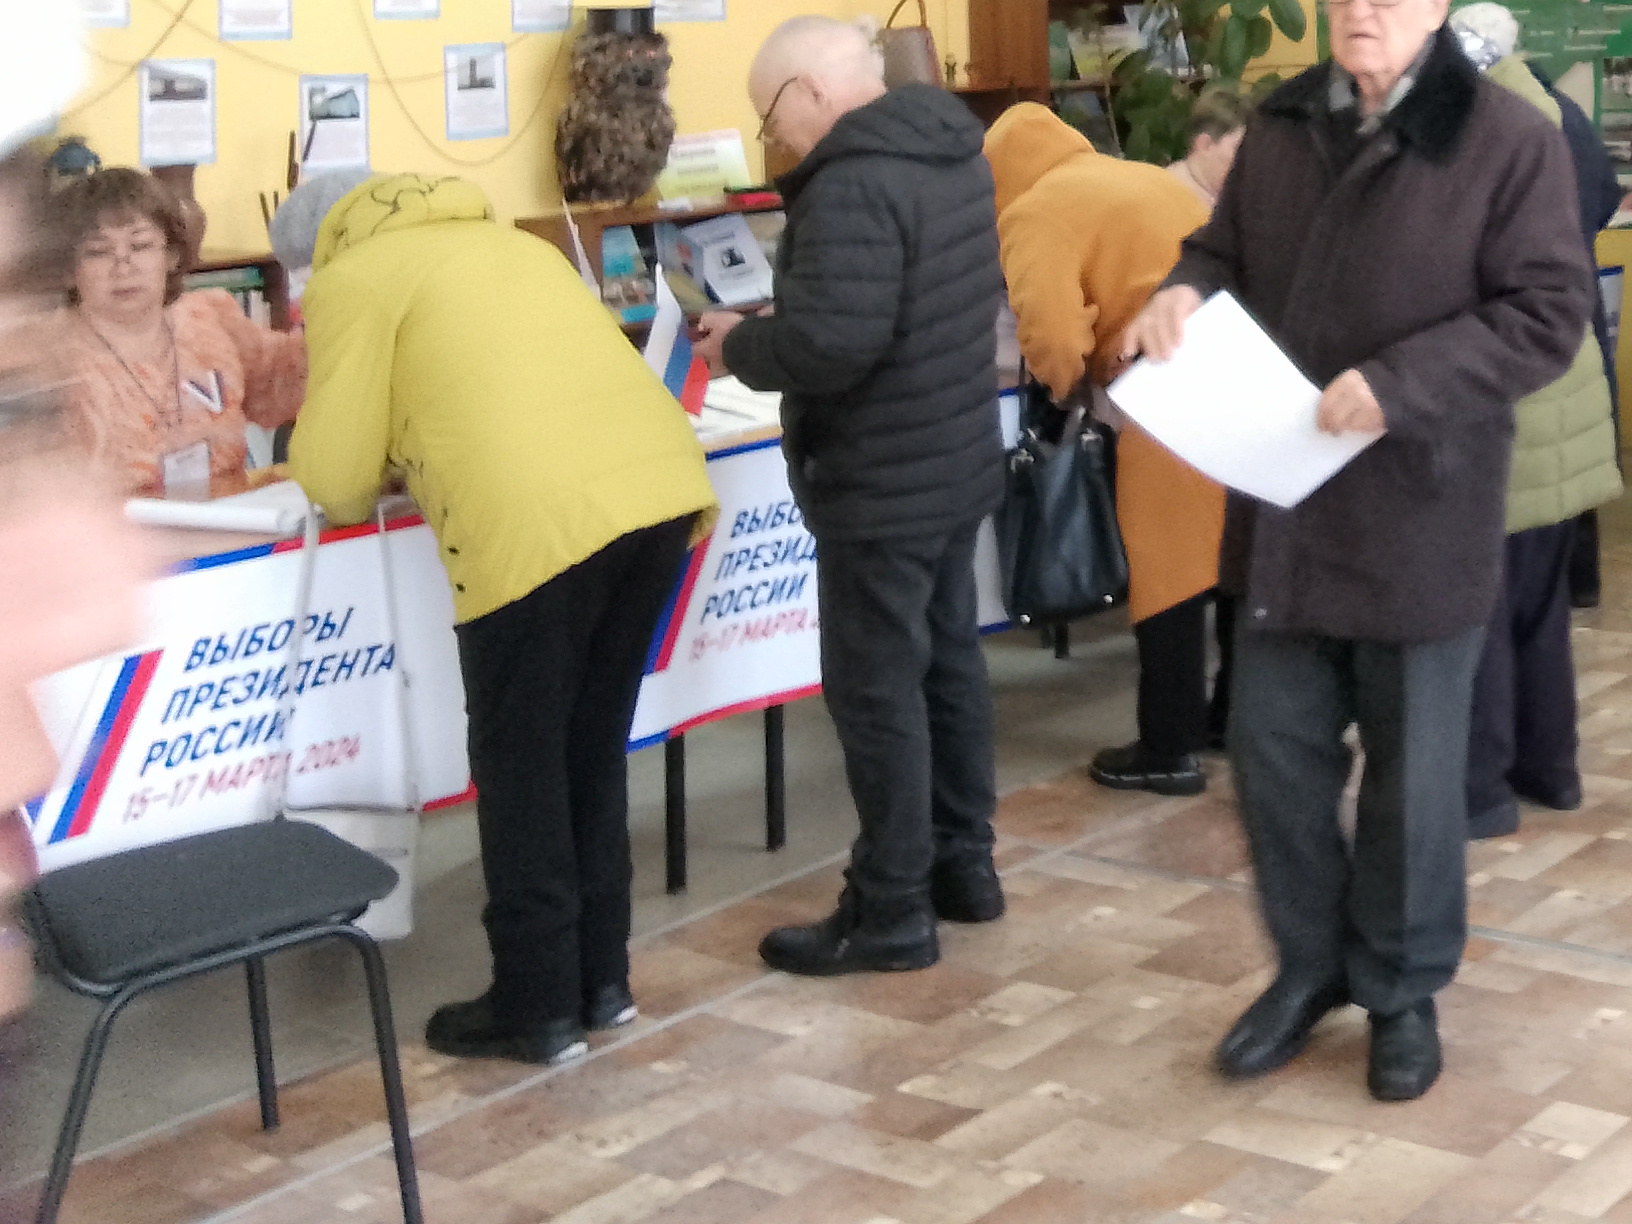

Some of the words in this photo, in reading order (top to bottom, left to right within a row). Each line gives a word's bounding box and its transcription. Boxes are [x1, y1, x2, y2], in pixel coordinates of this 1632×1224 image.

[730, 501, 806, 539] ВЫБО
[714, 535, 820, 581] ПРЕЗИД
[700, 573, 809, 626] РОССИИ
[184, 607, 355, 673] ВЫБОРЫ
[161, 642, 397, 726] ПРЕЗИДЕНТА
